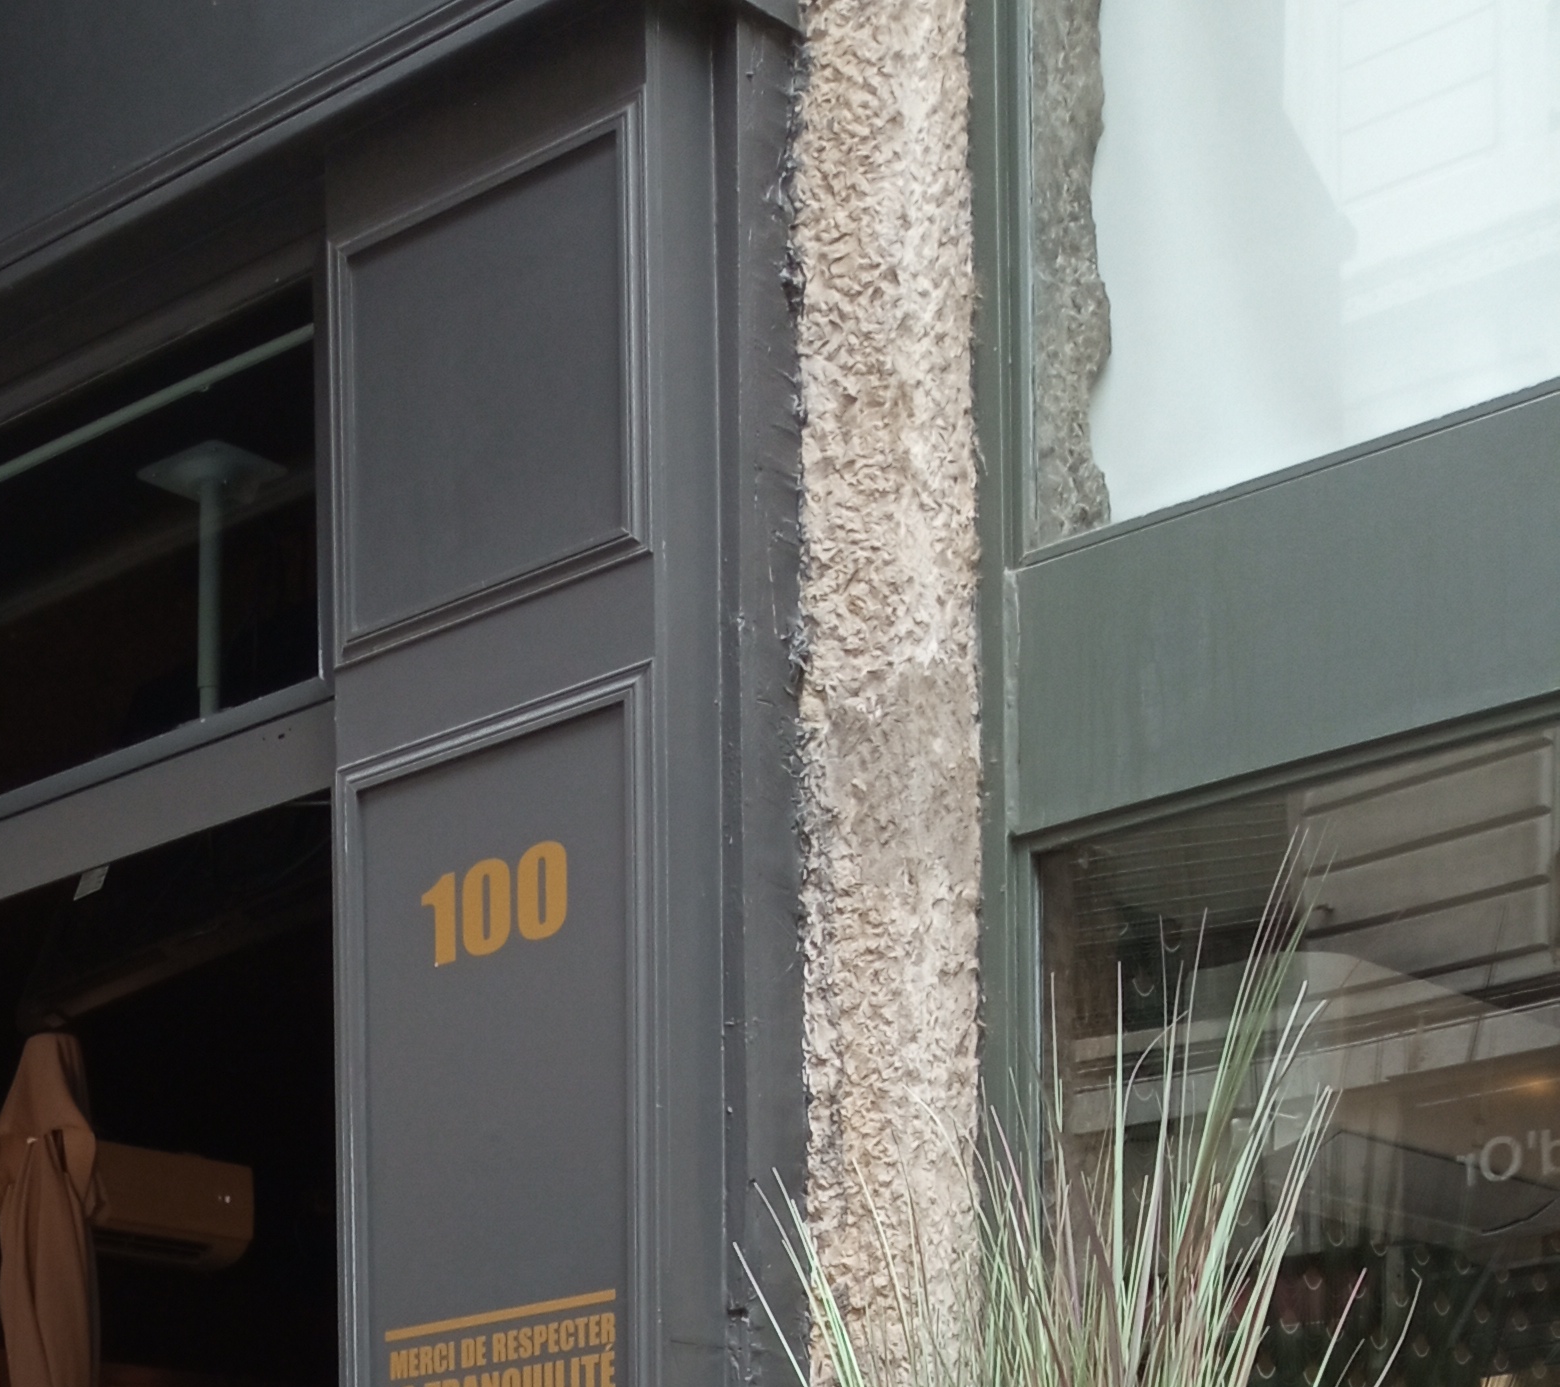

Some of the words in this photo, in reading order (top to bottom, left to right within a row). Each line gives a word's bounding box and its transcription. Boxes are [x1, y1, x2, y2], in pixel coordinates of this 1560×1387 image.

[420, 840, 568, 966] 100
[390, 1341, 456, 1381] MERCI
[461, 1335, 487, 1369] DE
[492, 1312, 616, 1364] RESPECTER
